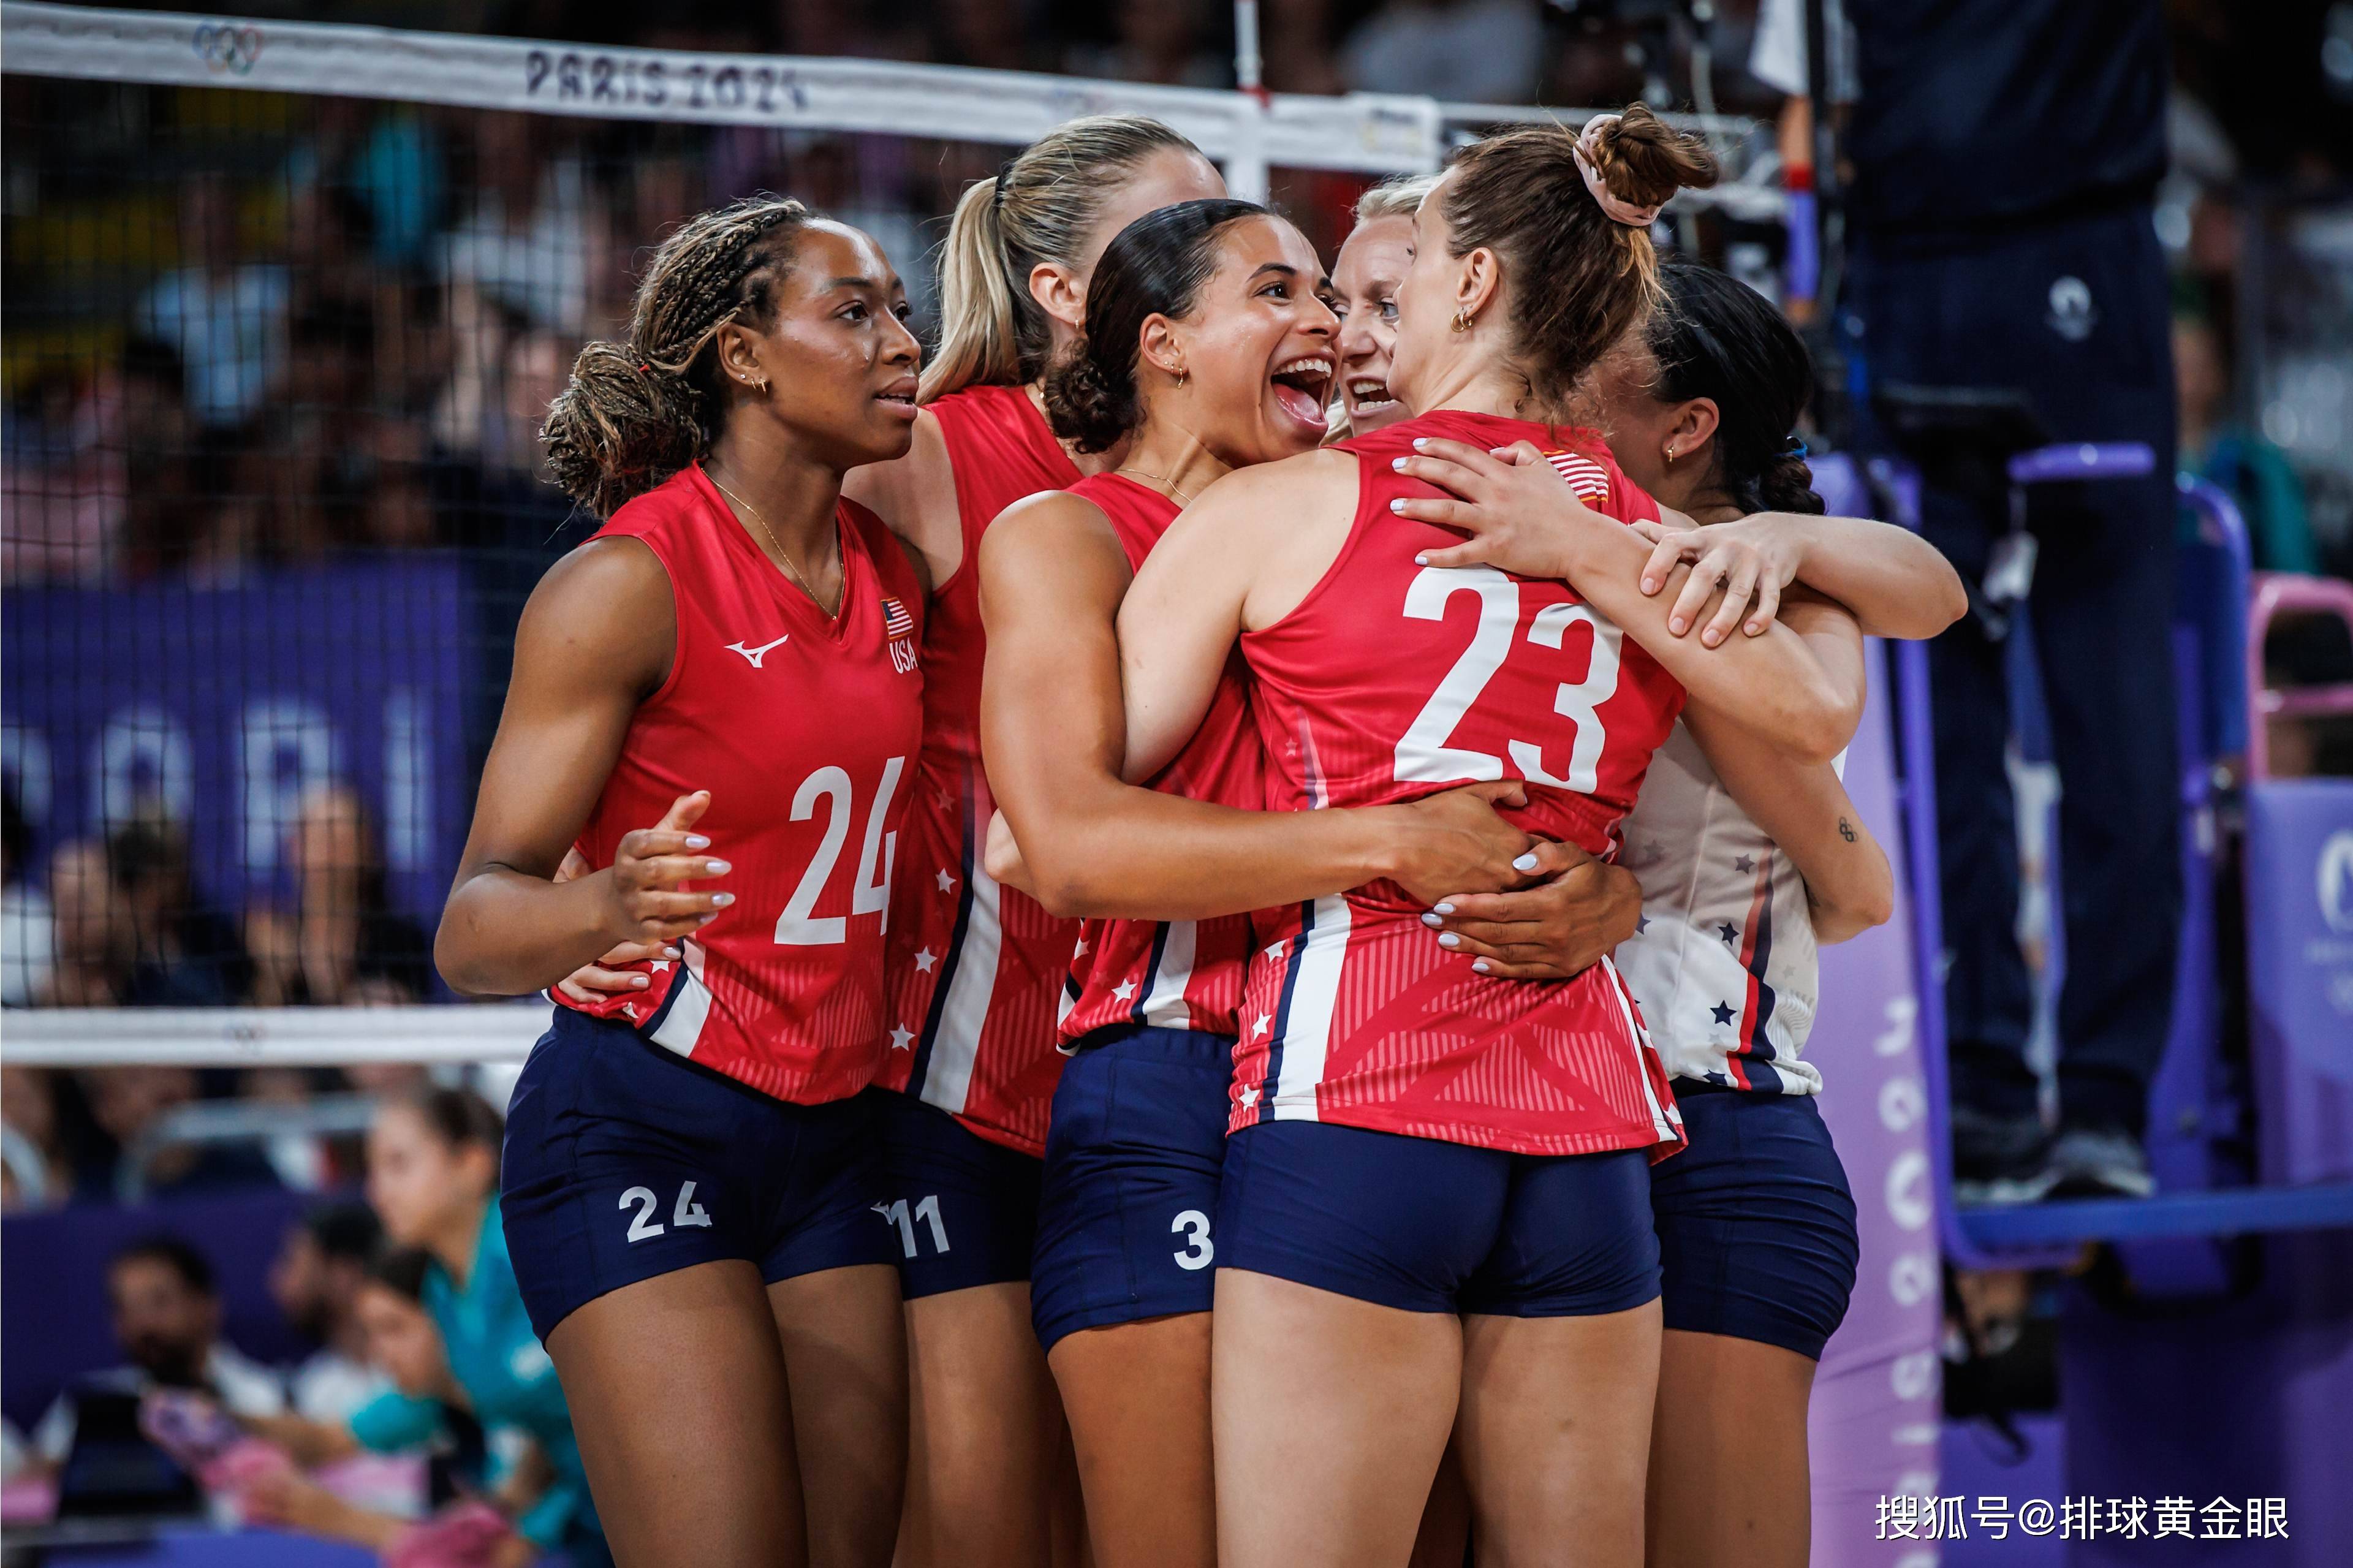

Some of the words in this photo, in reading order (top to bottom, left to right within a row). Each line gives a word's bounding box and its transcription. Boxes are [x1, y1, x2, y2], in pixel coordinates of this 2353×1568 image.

[525, 49, 668, 106] PARIS
[681, 63, 810, 113] 2024
[889, 637, 918, 673] USA
[1393, 562, 1624, 795] 23
[774, 756, 905, 944] 24
[618, 1180, 713, 1243] 24
[889, 1195, 950, 1259] 11
[1171, 1210, 1214, 1270] 3
